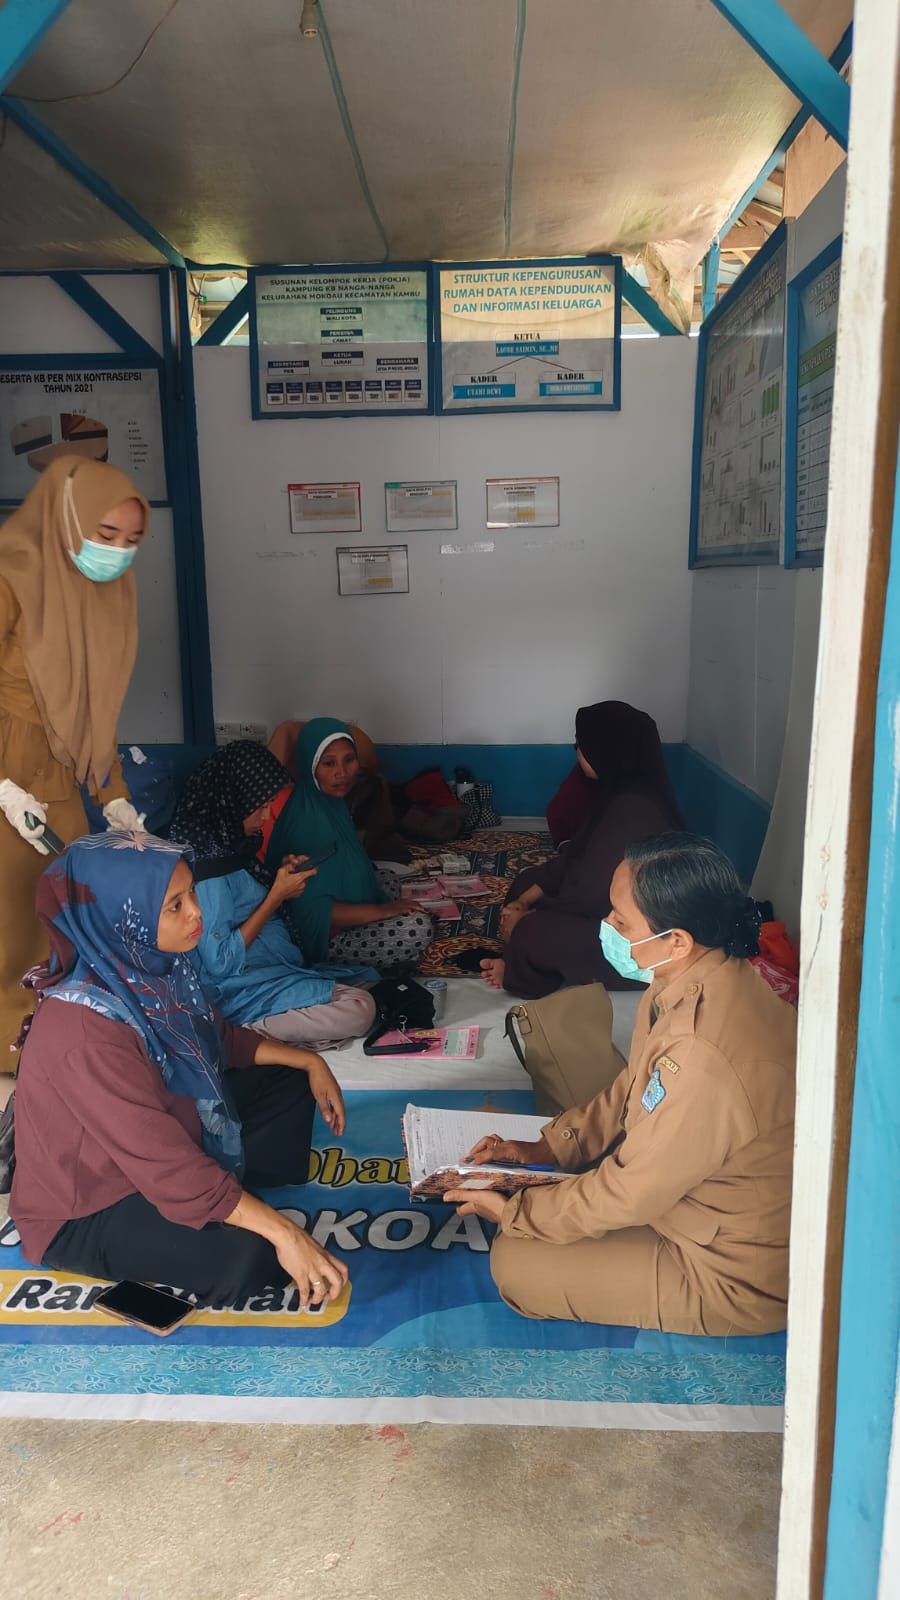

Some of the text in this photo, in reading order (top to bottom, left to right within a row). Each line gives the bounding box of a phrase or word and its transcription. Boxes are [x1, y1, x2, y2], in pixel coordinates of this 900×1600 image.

[270, 278, 307, 286] SUSUNAN
[309, 277, 350, 285] KELOMPOK
[453, 269, 602, 284] STRUKTUR KEPENGURUSAN
[285, 285, 324, 293] KAMPUNG
[443, 284, 612, 299] RUMAH DATA KEPENDUDUKAN
[261, 293, 307, 301] KELURAHAN
[345, 291, 391, 299] KECAMATAN
[393, 290, 420, 298] KAMBU
[453, 298, 602, 313] DAN INFORMASI KELUARGA
[513, 333, 541, 341] KETUA
[0, 372, 142, 383] ESERTA KB PER MIX KONTRASEPSI
[470, 375, 498, 384] KADER
[557, 372, 585, 381] KADER
[44, 383, 93, 393] TAHUN 2021
